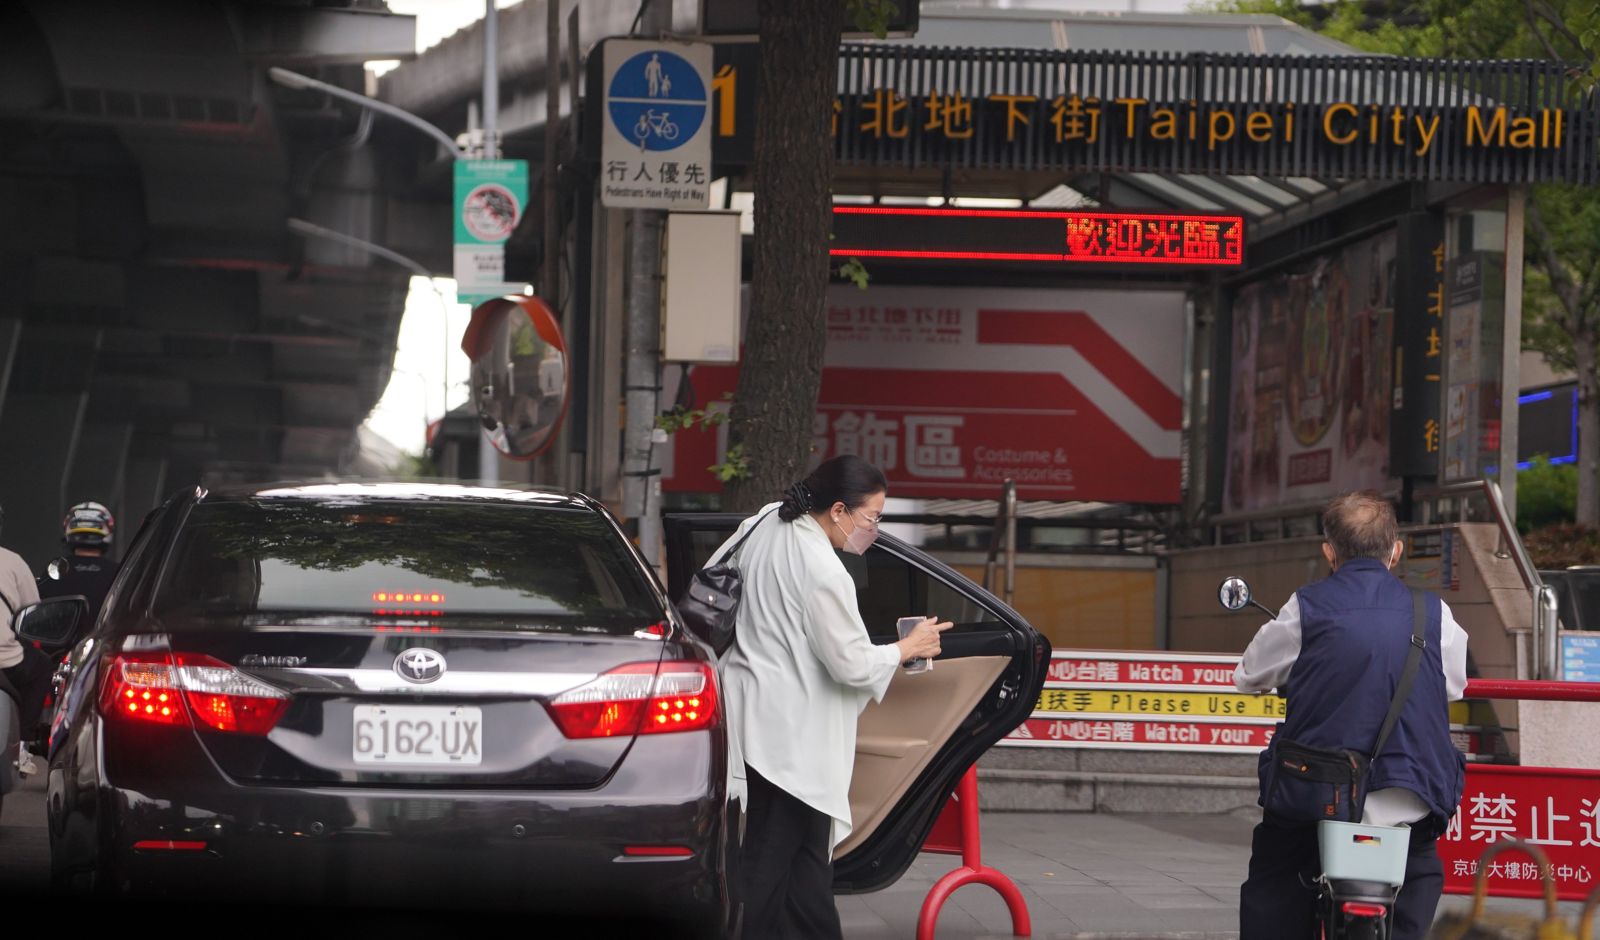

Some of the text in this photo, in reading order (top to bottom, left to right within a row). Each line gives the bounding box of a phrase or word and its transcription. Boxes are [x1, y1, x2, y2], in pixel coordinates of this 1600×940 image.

[832, 89, 1563, 156] 北地下街 Taipei City Mall
[608, 160, 705, 185] 行人優先
[606, 186, 704, 202] Pedestrians Have Right of Way
[812, 411, 966, 478] 飾區
[974, 446, 1067, 464] Costume &
[974, 464, 1073, 482] Accessories
[1048, 661, 1233, 685] 心台階 Watch your
[1111, 694, 1191, 713] Please
[1208, 697, 1247, 714] Use
[1048, 722, 1135, 742] 小心台階
[1145, 723, 1200, 742] Watch
[1210, 728, 1255, 745] your
